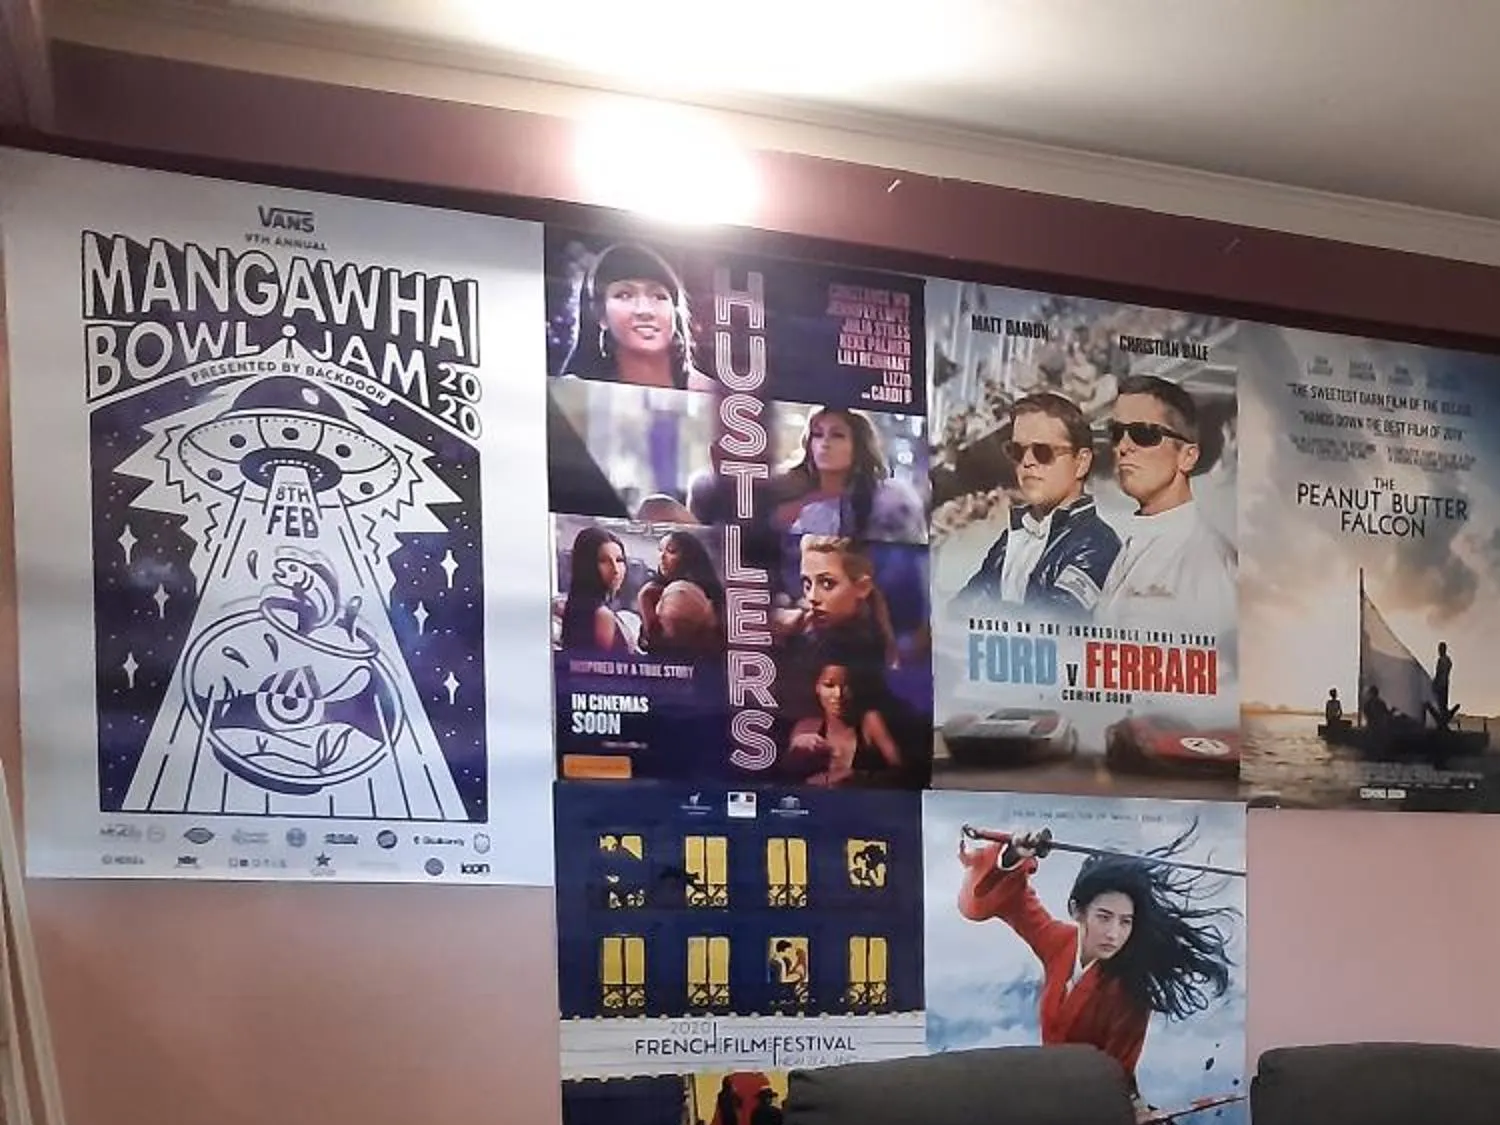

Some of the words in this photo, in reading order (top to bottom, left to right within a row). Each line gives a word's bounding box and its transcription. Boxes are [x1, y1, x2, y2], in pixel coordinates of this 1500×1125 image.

[258, 206, 314, 232] VANS
[82, 230, 480, 365] MANGAWHAI
[971, 314, 1002, 334] MATT
[1005, 319, 1049, 342] DAMON
[1119, 335, 1180, 358] CHRISTIAN
[86, 320, 260, 402] BOWL
[312, 329, 431, 408] JAM
[192, 361, 277, 383] PRESENTED
[281, 361, 300, 374] BY
[305, 365, 387, 401] BACKDOOR
[438, 363, 482, 404] 20
[1310, 384, 1358, 404] SWEETEST
[1385, 394, 1407, 409] FILM
[438, 394, 482, 440] 20
[1383, 419, 1405, 433] BEST
[1407, 422, 1428, 437] FILM
[1429, 424, 1441, 437] OF
[276, 486, 311, 504] 8TH
[1373, 477, 1397, 491] THE
[1296, 481, 1382, 512] PEANUT
[1391, 492, 1468, 521] BUTTER
[267, 505, 320, 539] FEB
[715, 269, 780, 771] HUSTLERS
[1340, 511, 1425, 538] FALCON
[969, 618, 1009, 633] BASED
[1068, 625, 1140, 641] INCREDIBLE
[969, 633, 1057, 686] FORD
[1085, 641, 1218, 696] FERRARI
[571, 693, 587, 711] IN
[589, 694, 649, 713] CINEMAS
[1062, 689, 1101, 703] COMING
[1106, 691, 1133, 704] SOON
[571, 711, 621, 735] SOON
[635, 1029, 717, 1055] FRENCH
[723, 1036, 767, 1052] FILM
[773, 1035, 856, 1055] FESTIVAL
